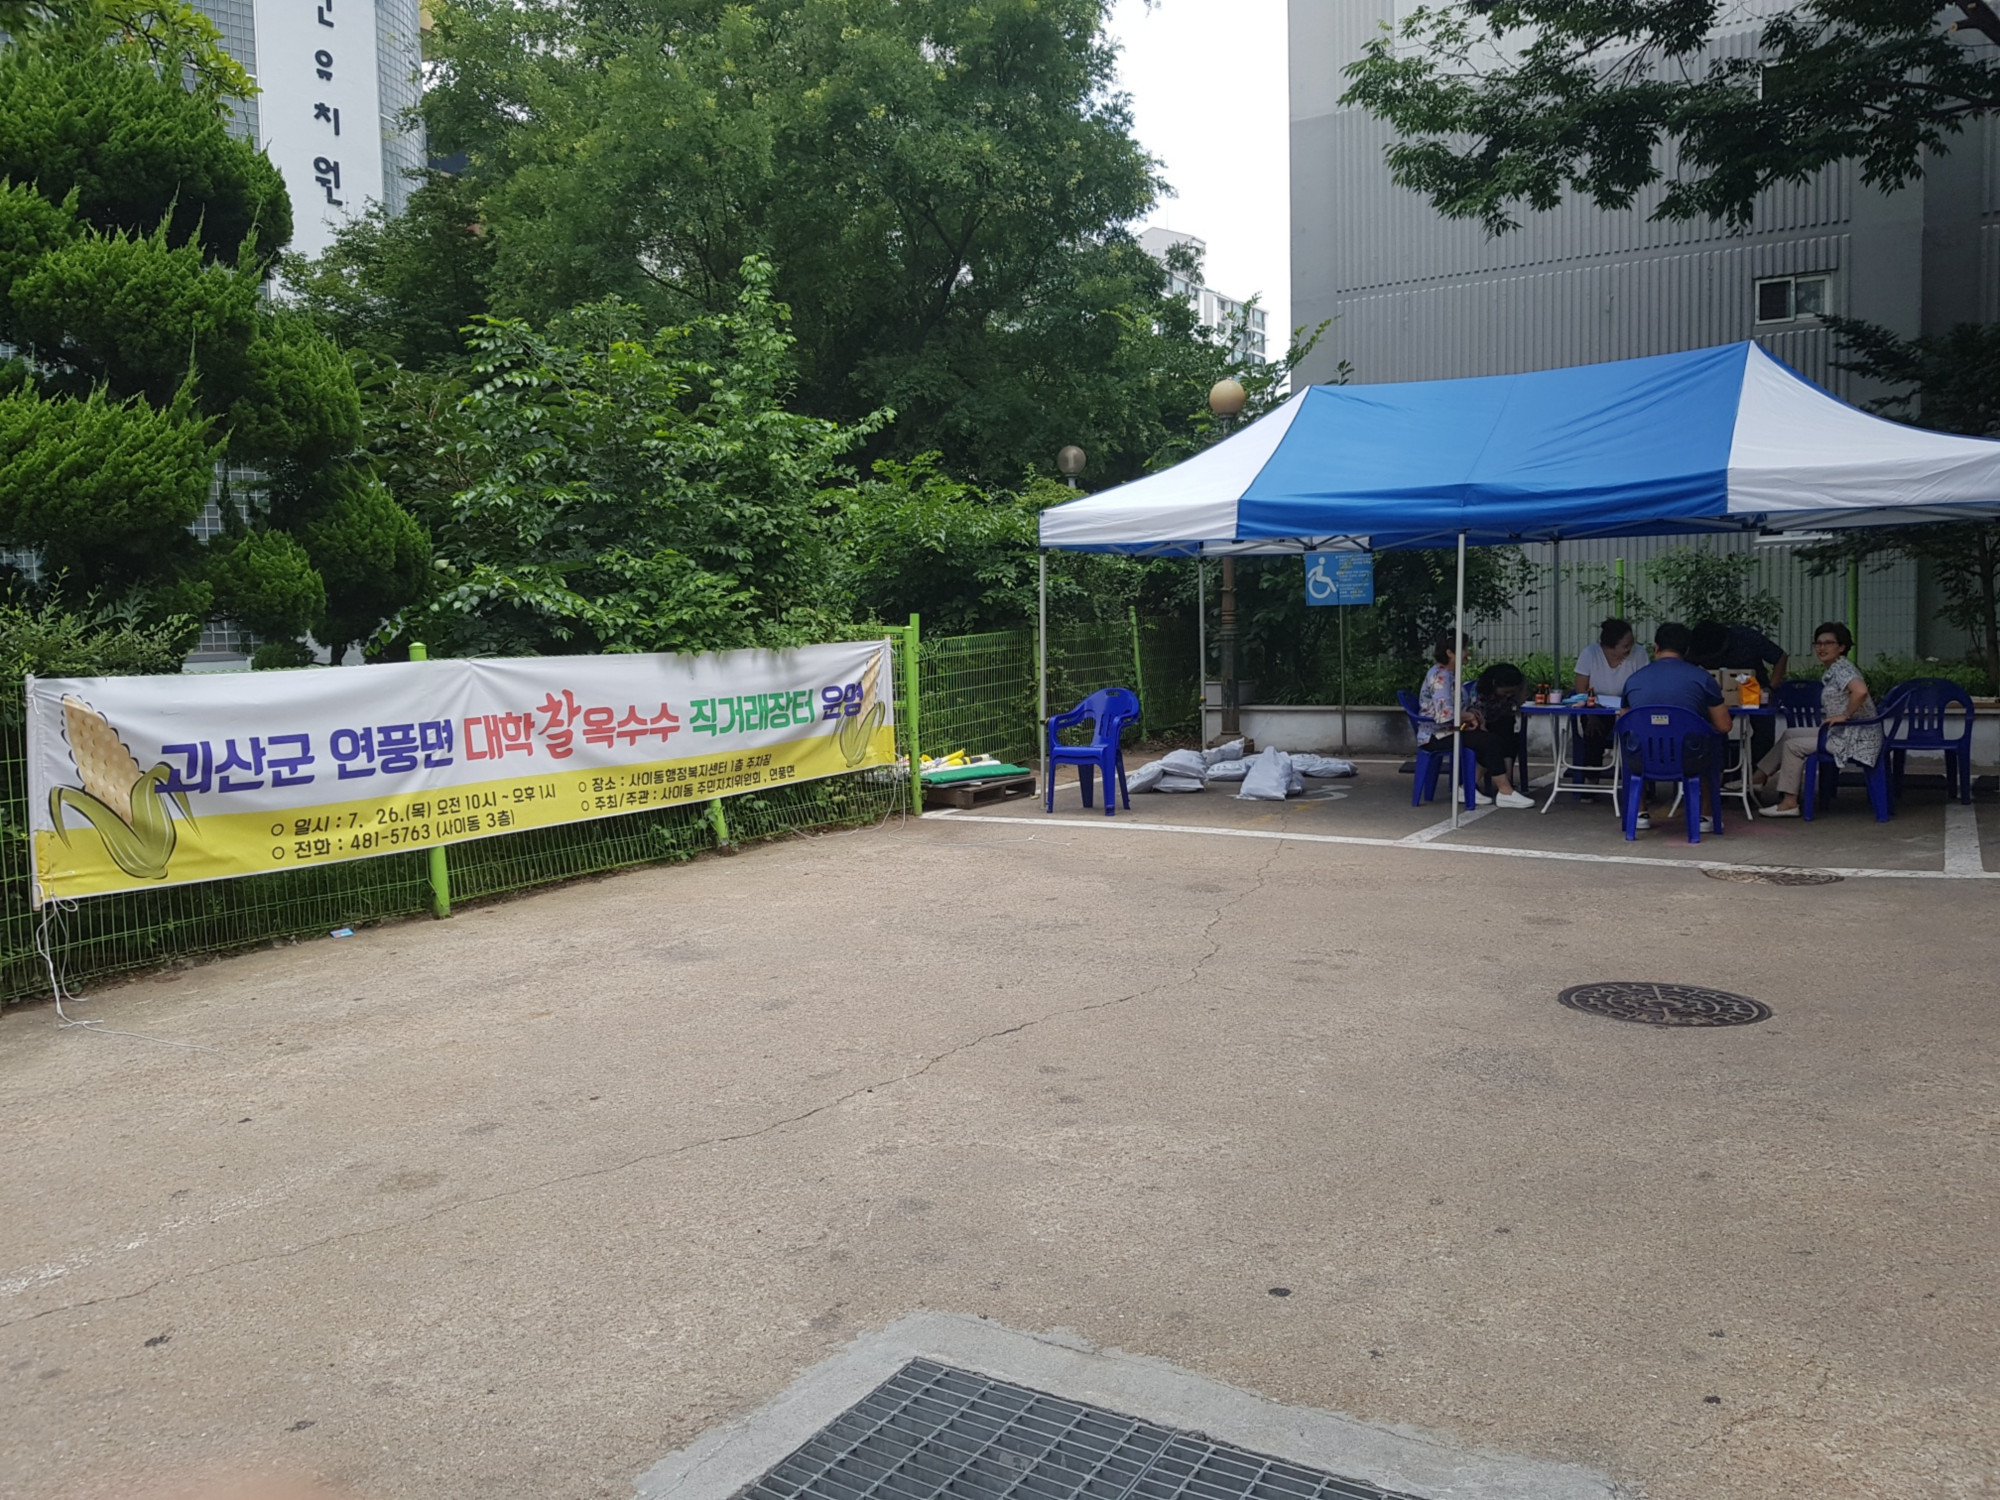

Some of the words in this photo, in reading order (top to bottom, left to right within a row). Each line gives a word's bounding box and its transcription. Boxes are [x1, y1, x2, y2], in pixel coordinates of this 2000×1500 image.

[154, 733, 315, 794] 괴산군
[330, 719, 453, 780] 연풍면
[464, 689, 680, 761] 대학찰옥수수
[689, 689, 815, 737] 직거래장터
[821, 681, 864, 721] 운영
[592, 776, 616, 793] 장소
[628, 761, 727, 787] 사이동행정복지센터
[730, 758, 744, 772] 1층
[746, 753, 772, 771] 주차장
[594, 789, 650, 811] 주최/주관
[661, 783, 694, 801] 사이동
[697, 771, 761, 795] 주민자치위원회
[769, 765, 795, 782] 연풍면
[294, 816, 330, 836] 일시
[349, 812, 363, 829] 7.
[376, 801, 431, 825] 26.(목)
[437, 796, 461, 816] 오전
[465, 791, 497, 810] 10시
[512, 786, 536, 804] 오후
[538, 783, 556, 800] 1시
[294, 838, 331, 860] 전화
[350, 823, 431, 850] 481-5763
[436, 814, 480, 838] (사이동
[486, 809, 515, 828] 3층)
